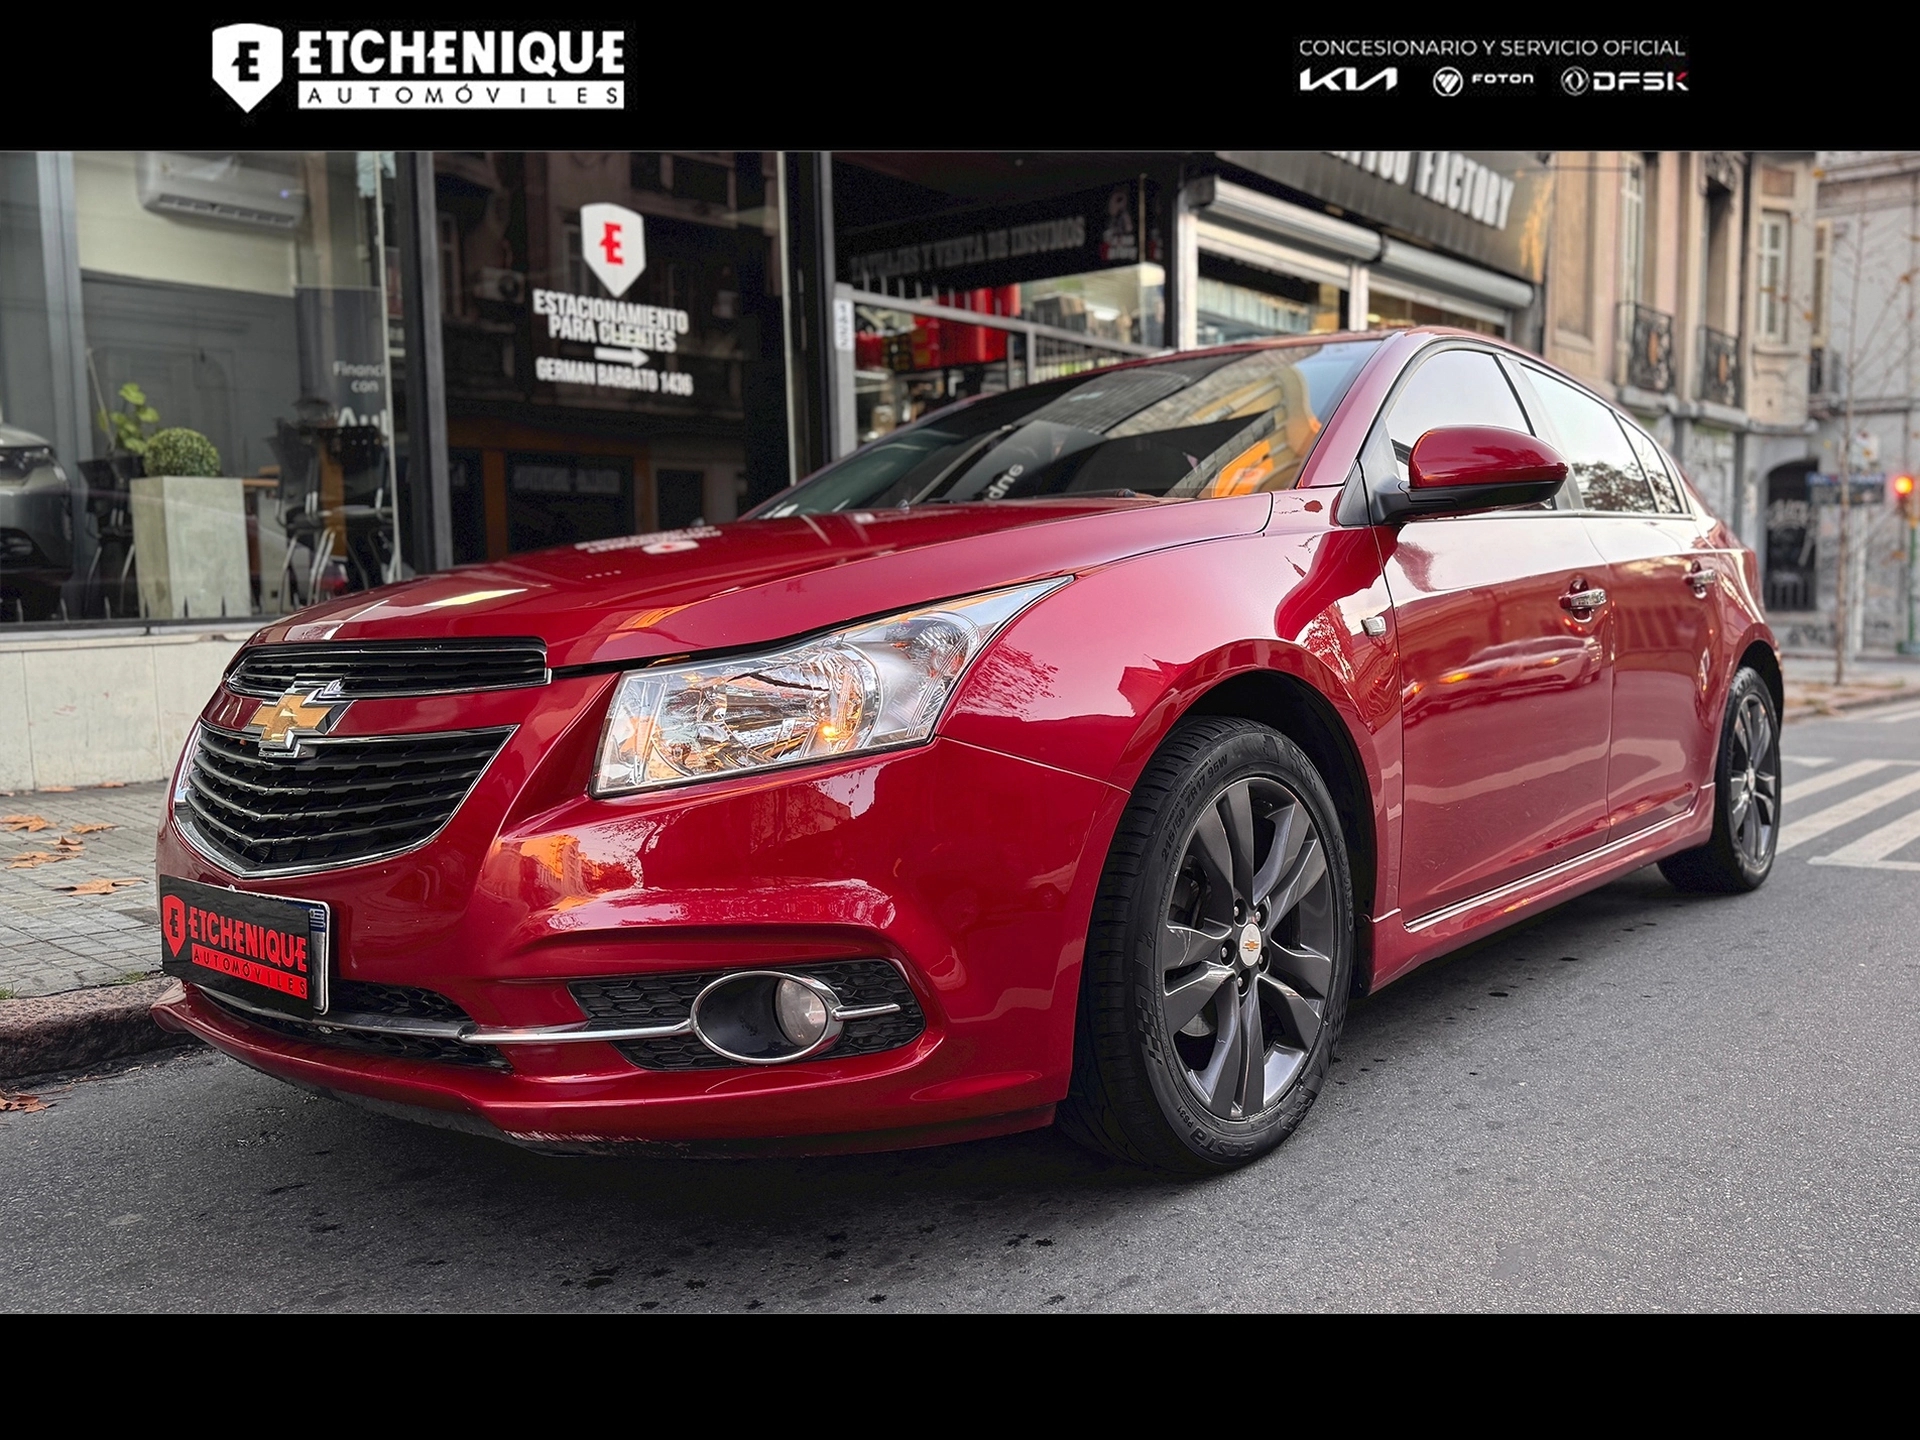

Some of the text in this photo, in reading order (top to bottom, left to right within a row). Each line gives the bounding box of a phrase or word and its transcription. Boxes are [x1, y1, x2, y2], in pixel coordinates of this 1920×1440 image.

[1413, 150, 1514, 231] FACTORY
[532, 288, 690, 334] ESTACIONAMIENTO
[549, 314, 677, 352] PARA CLIENTES
[350, 380, 379, 393] con
[535, 356, 596, 385] GERMAN
[188, 905, 308, 973] ETCHENIQUE
[193, 948, 307, 995] AUTOMÓVILES
